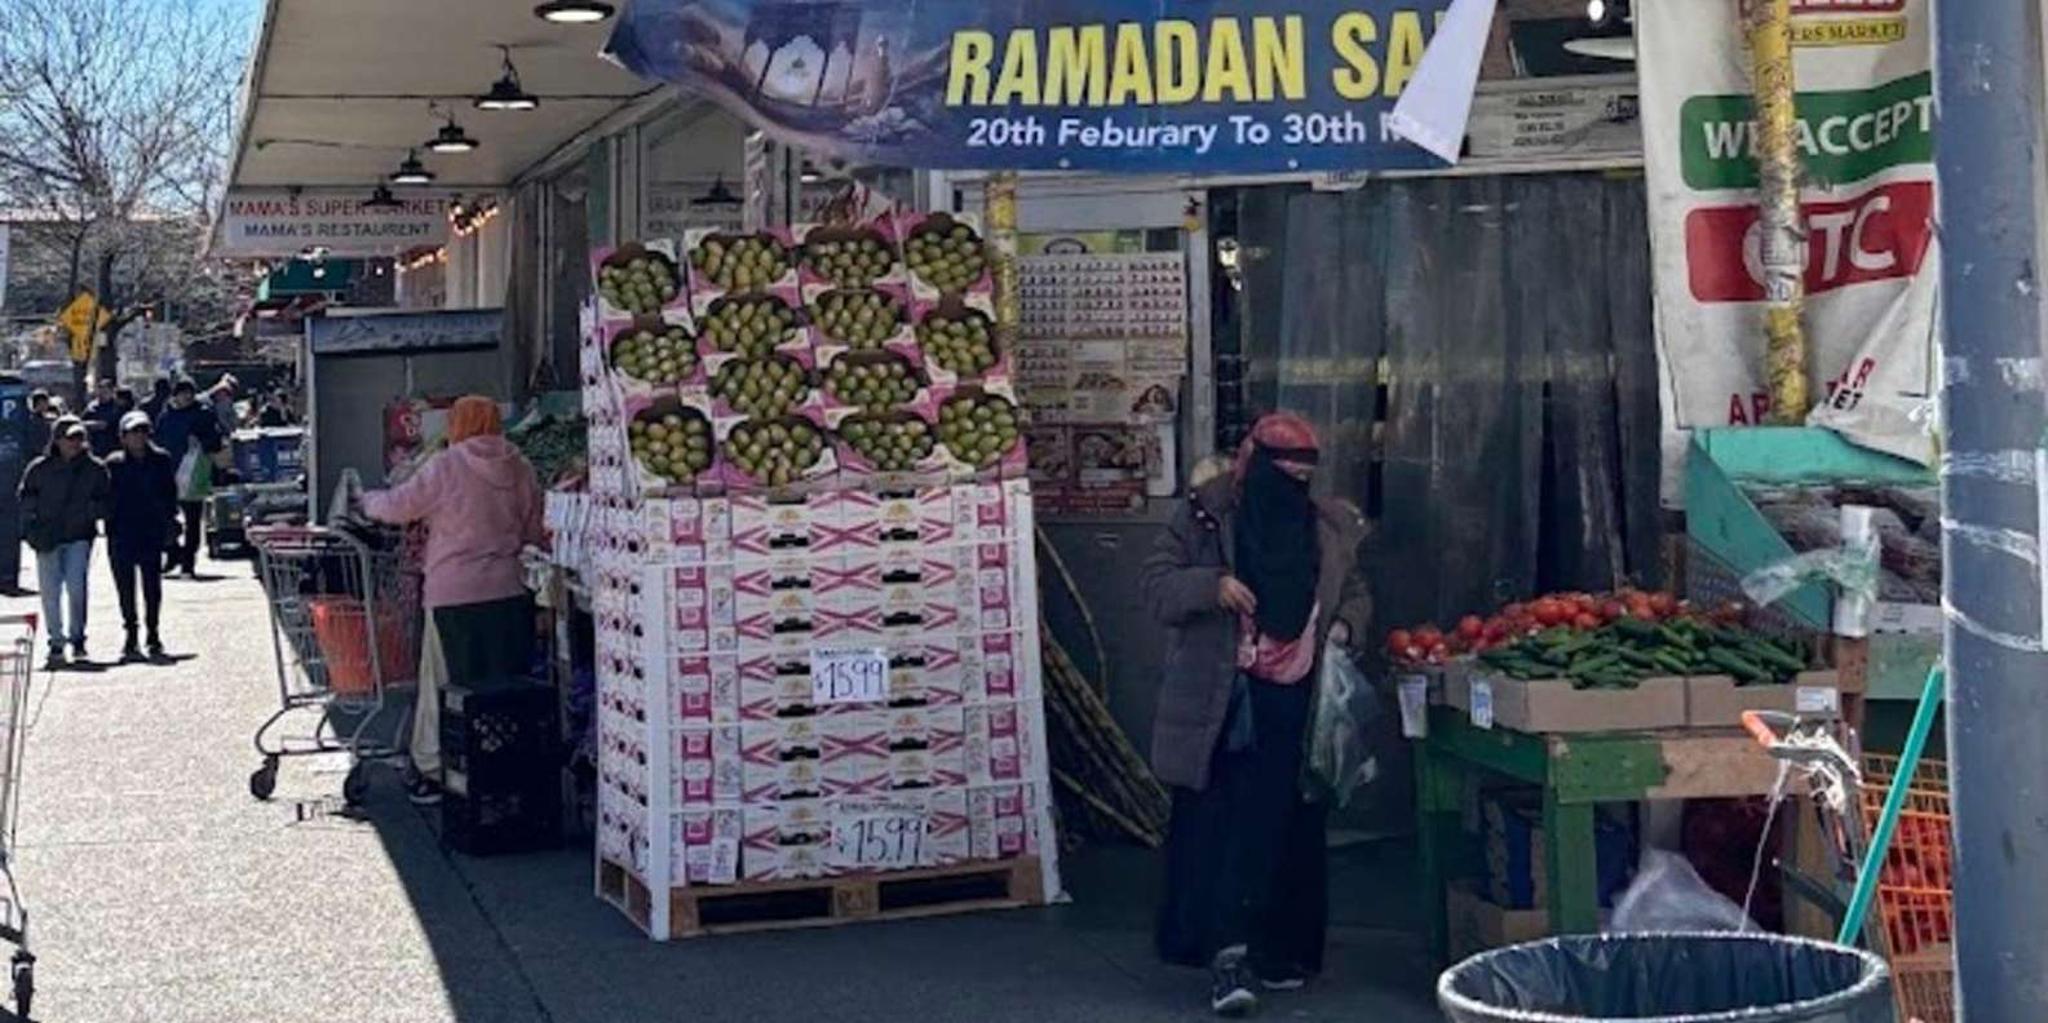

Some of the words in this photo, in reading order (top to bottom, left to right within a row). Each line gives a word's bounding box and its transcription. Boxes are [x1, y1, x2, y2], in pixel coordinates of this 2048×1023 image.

[946, 16, 1306, 107] RAMADAN
[1331, 11, 1446, 100] SA
[967, 117, 1045, 147] 20th
[1057, 116, 1216, 153] Feburary
[1228, 116, 1272, 145] To
[1283, 111, 1366, 144] 30th
[1794, 96, 1932, 156] ACCEPT
[306, 199, 364, 215] SUPER
[244, 222, 312, 237] MAMA'S
